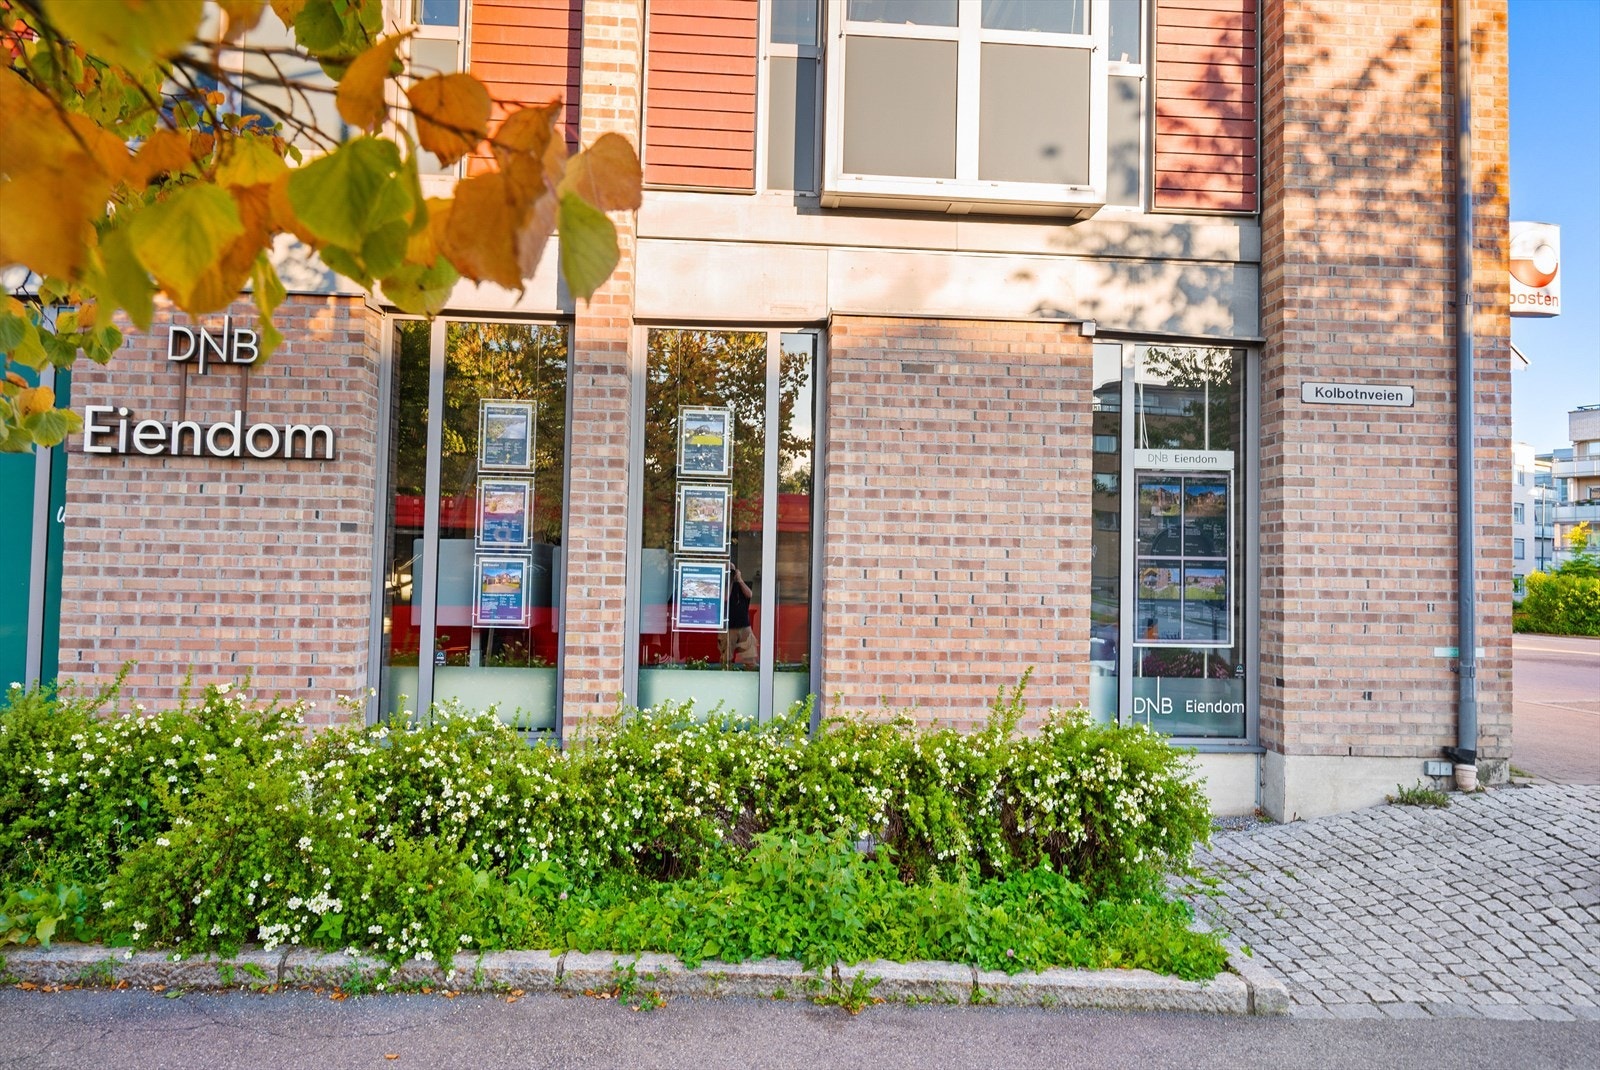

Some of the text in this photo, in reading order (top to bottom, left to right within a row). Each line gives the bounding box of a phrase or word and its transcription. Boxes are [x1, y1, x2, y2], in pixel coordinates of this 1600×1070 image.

[168, 315, 259, 375] DNB
[1315, 386, 1403, 401] Kolbotnveien
[83, 405, 334, 460] Eiendom
[1148, 451, 1217, 465] DNB Eiendom
[1134, 676, 1245, 734] DNB Eiendom
